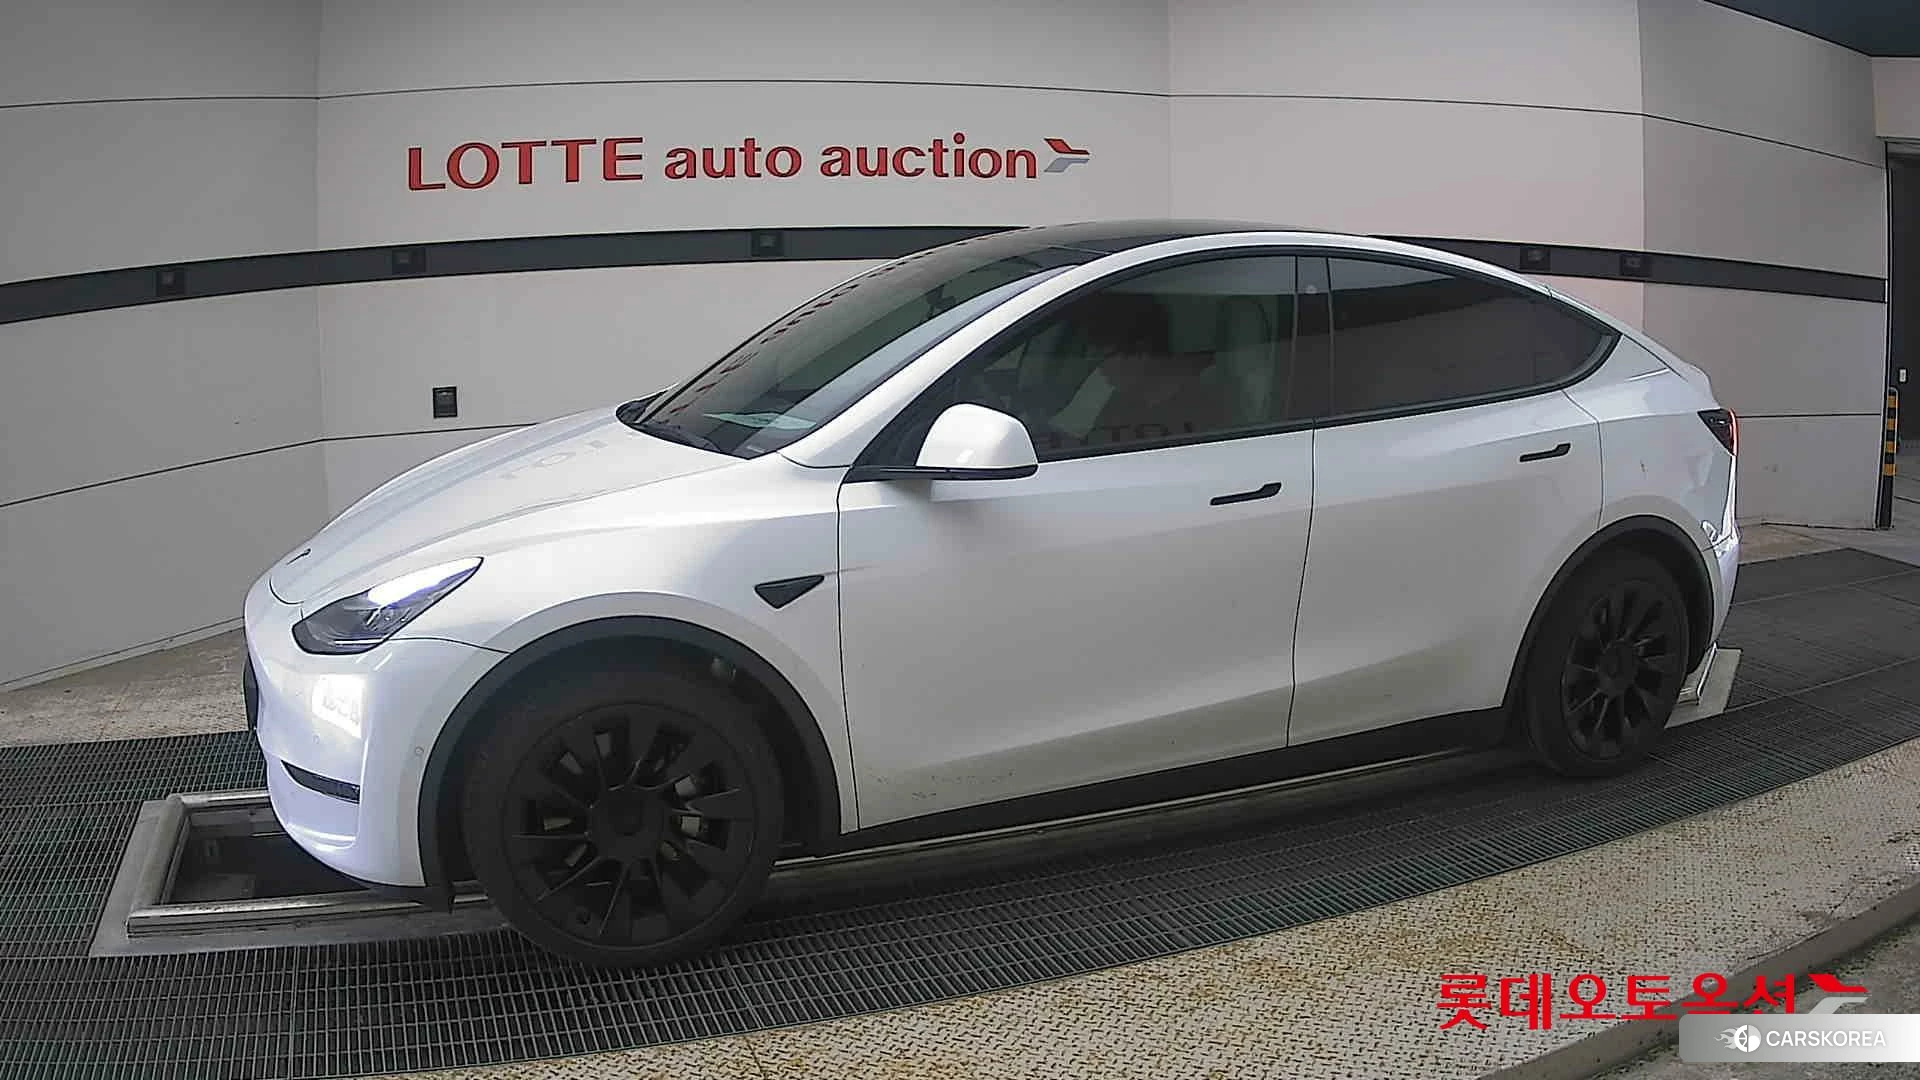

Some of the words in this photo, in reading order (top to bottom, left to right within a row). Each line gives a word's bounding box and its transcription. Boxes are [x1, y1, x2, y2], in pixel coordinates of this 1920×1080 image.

[407, 137, 643, 191] LOTTE
[663, 137, 802, 178] auto
[819, 132, 1039, 178] auction
